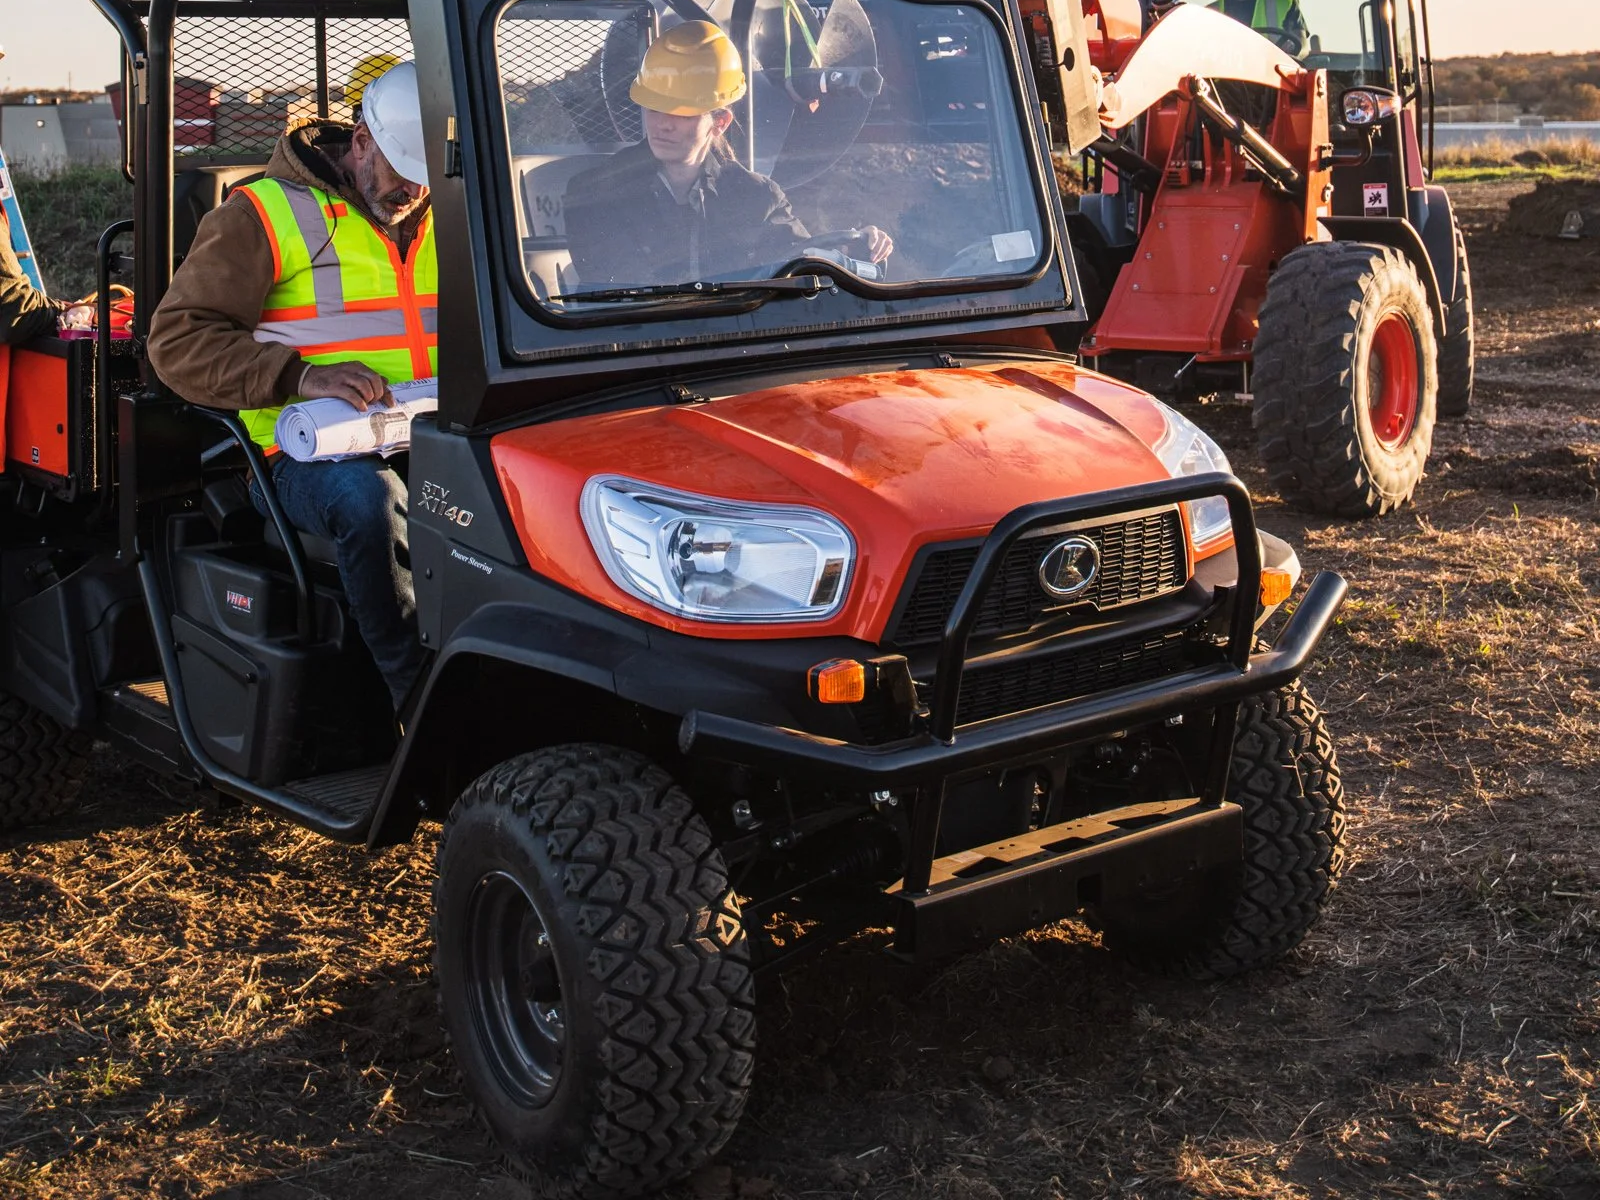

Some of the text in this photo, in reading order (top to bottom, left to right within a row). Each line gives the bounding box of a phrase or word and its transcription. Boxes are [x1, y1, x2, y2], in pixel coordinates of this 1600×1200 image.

[422, 480, 450, 499] RTV
[417, 491, 474, 527] X1140
[450, 548, 493, 575] Power Steering
